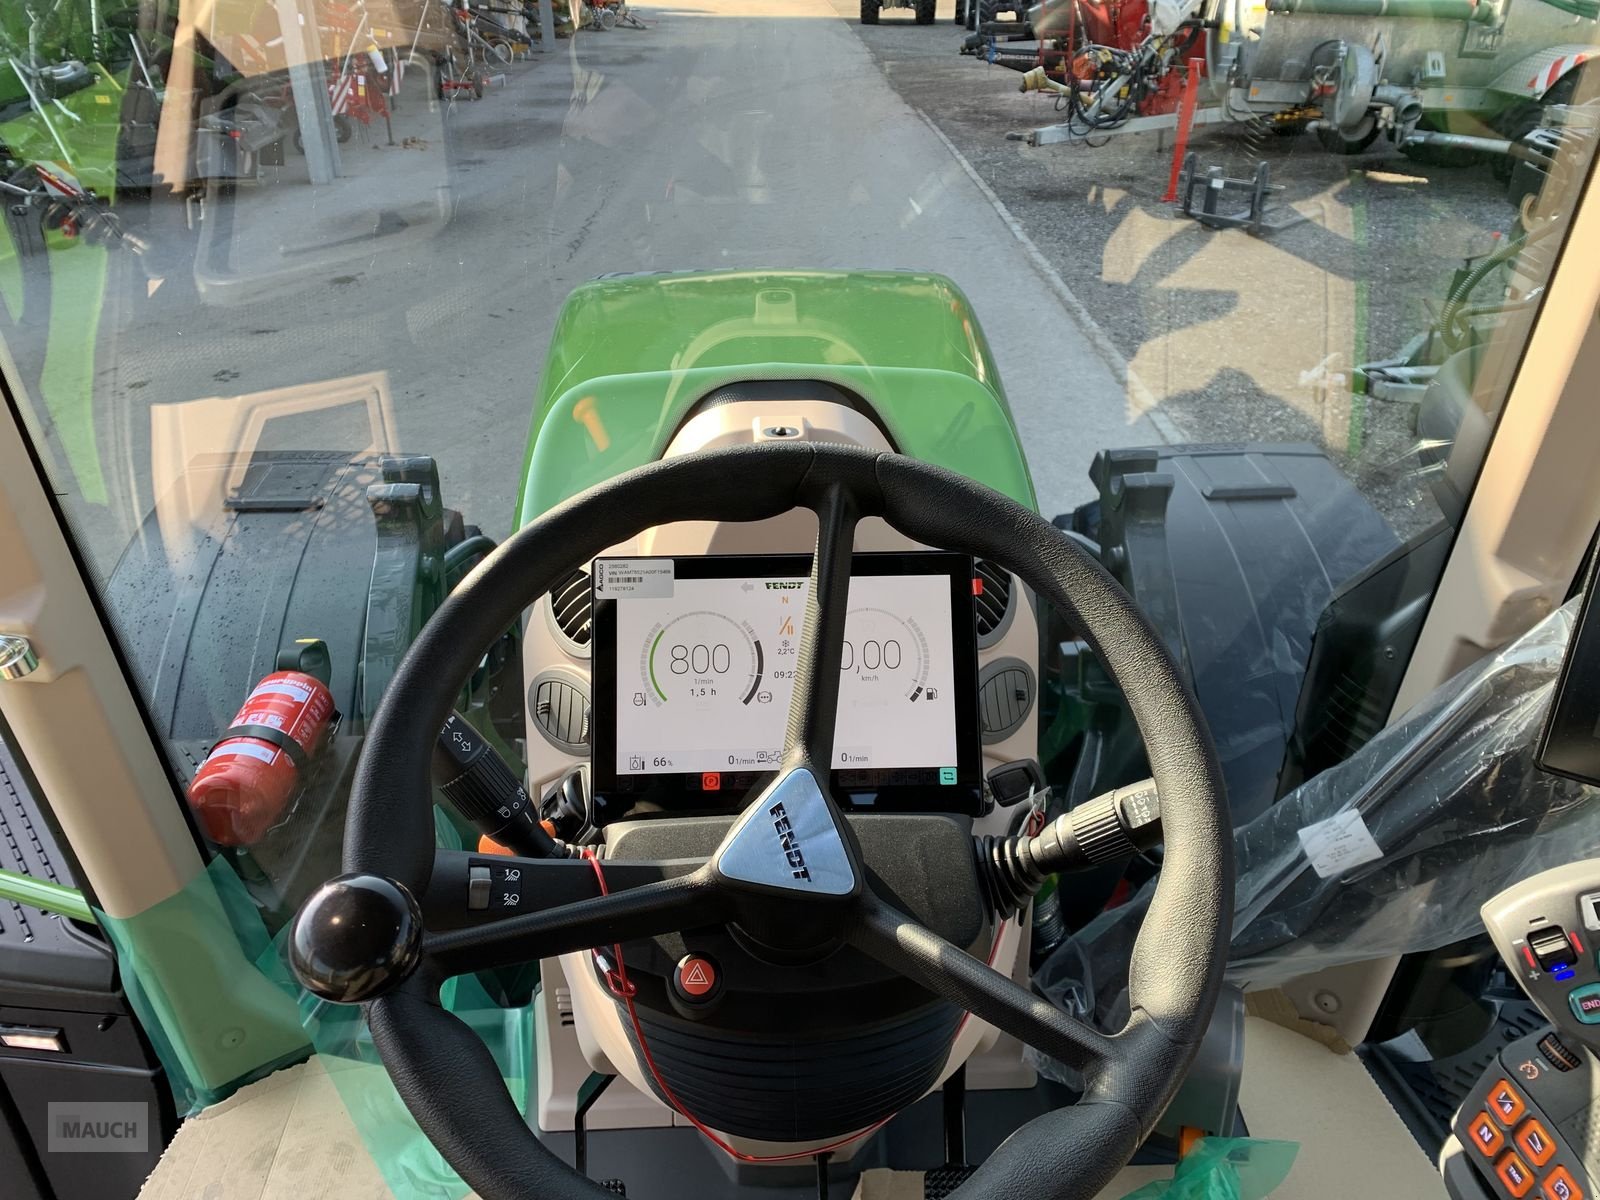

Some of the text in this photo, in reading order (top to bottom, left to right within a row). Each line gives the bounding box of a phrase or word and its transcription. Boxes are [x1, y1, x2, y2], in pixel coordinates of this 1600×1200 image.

[765, 582, 804, 590] FENDT
[782, 596, 789, 604] N
[670, 644, 730, 675] 800
[690, 688, 717, 697] 1,5 h
[653, 757, 667, 767] 66
[728, 755, 735, 765] 0
[841, 752, 848, 762] 0
[768, 801, 812, 882] FENDT
[1582, 999, 1600, 1010] END
[1480, 1126, 1493, 1142] N
